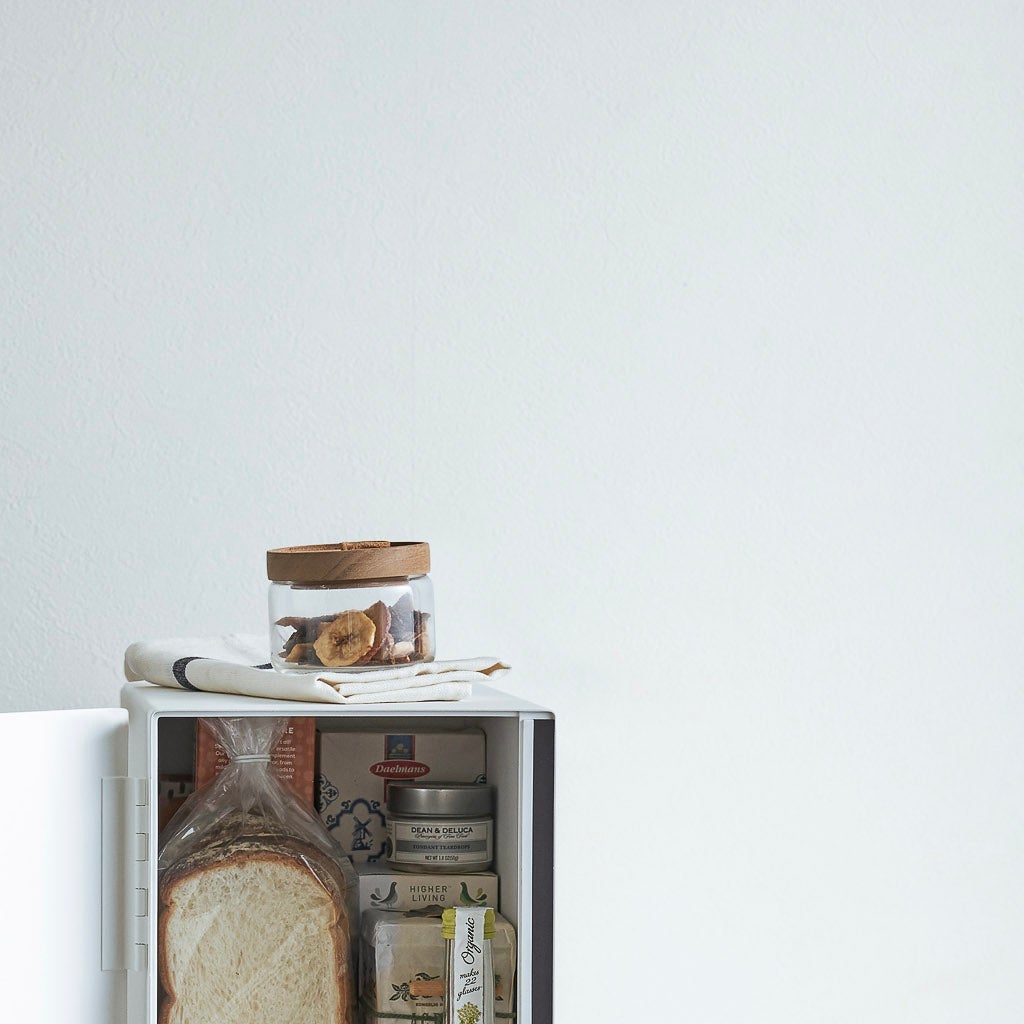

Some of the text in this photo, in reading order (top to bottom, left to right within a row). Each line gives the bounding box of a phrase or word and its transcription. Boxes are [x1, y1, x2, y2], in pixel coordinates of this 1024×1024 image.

[375, 764, 426, 774] Daelmans
[411, 826, 433, 834] DEAN
[442, 826, 474, 834] DELUCA
[412, 894, 446, 902] LIVING
[460, 917, 482, 965] Organic
[459, 968, 480, 979] makes
[464, 977, 477, 987] 22
